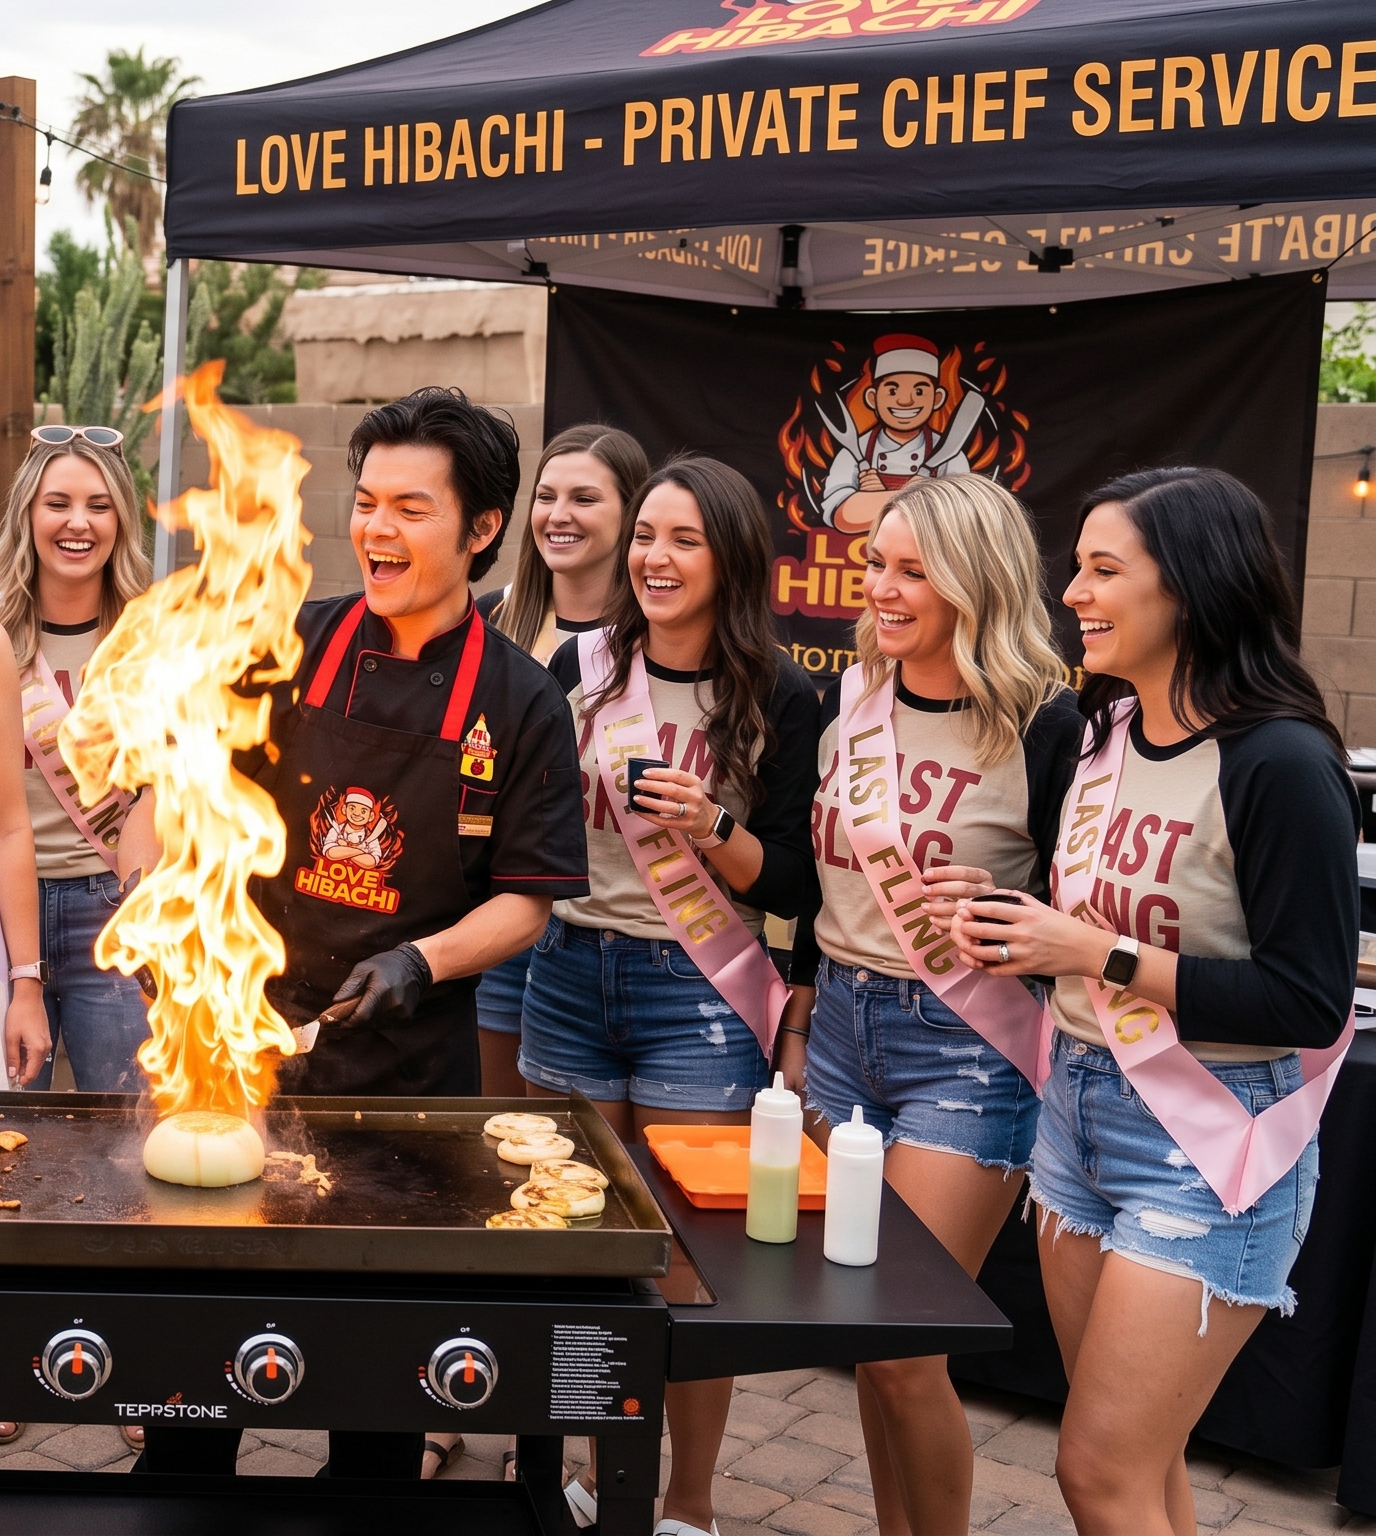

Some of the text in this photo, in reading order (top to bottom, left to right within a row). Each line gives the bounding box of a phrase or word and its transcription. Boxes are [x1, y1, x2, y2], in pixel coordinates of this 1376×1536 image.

[652, 0, 1033, 54] HIBACHI
[736, 0, 972, 28] LOV
[236, 129, 347, 195] LOVE
[364, 109, 565, 187] HIBACHI
[624, 83, 859, 166] PRIVATE
[882, 67, 1048, 148] CHEF
[1071, 39, 1376, 136] SERVICE
[814, 534, 869, 566] LO
[848, 724, 889, 828] LAST
[1064, 773, 1113, 878] LAST
[1099, 807, 1194, 885] AST
[297, 870, 396, 910] HIBACHI
[317, 858, 380, 888] LOVE
[637, 828, 729, 945] FLING
[867, 845, 956, 976] FLING
